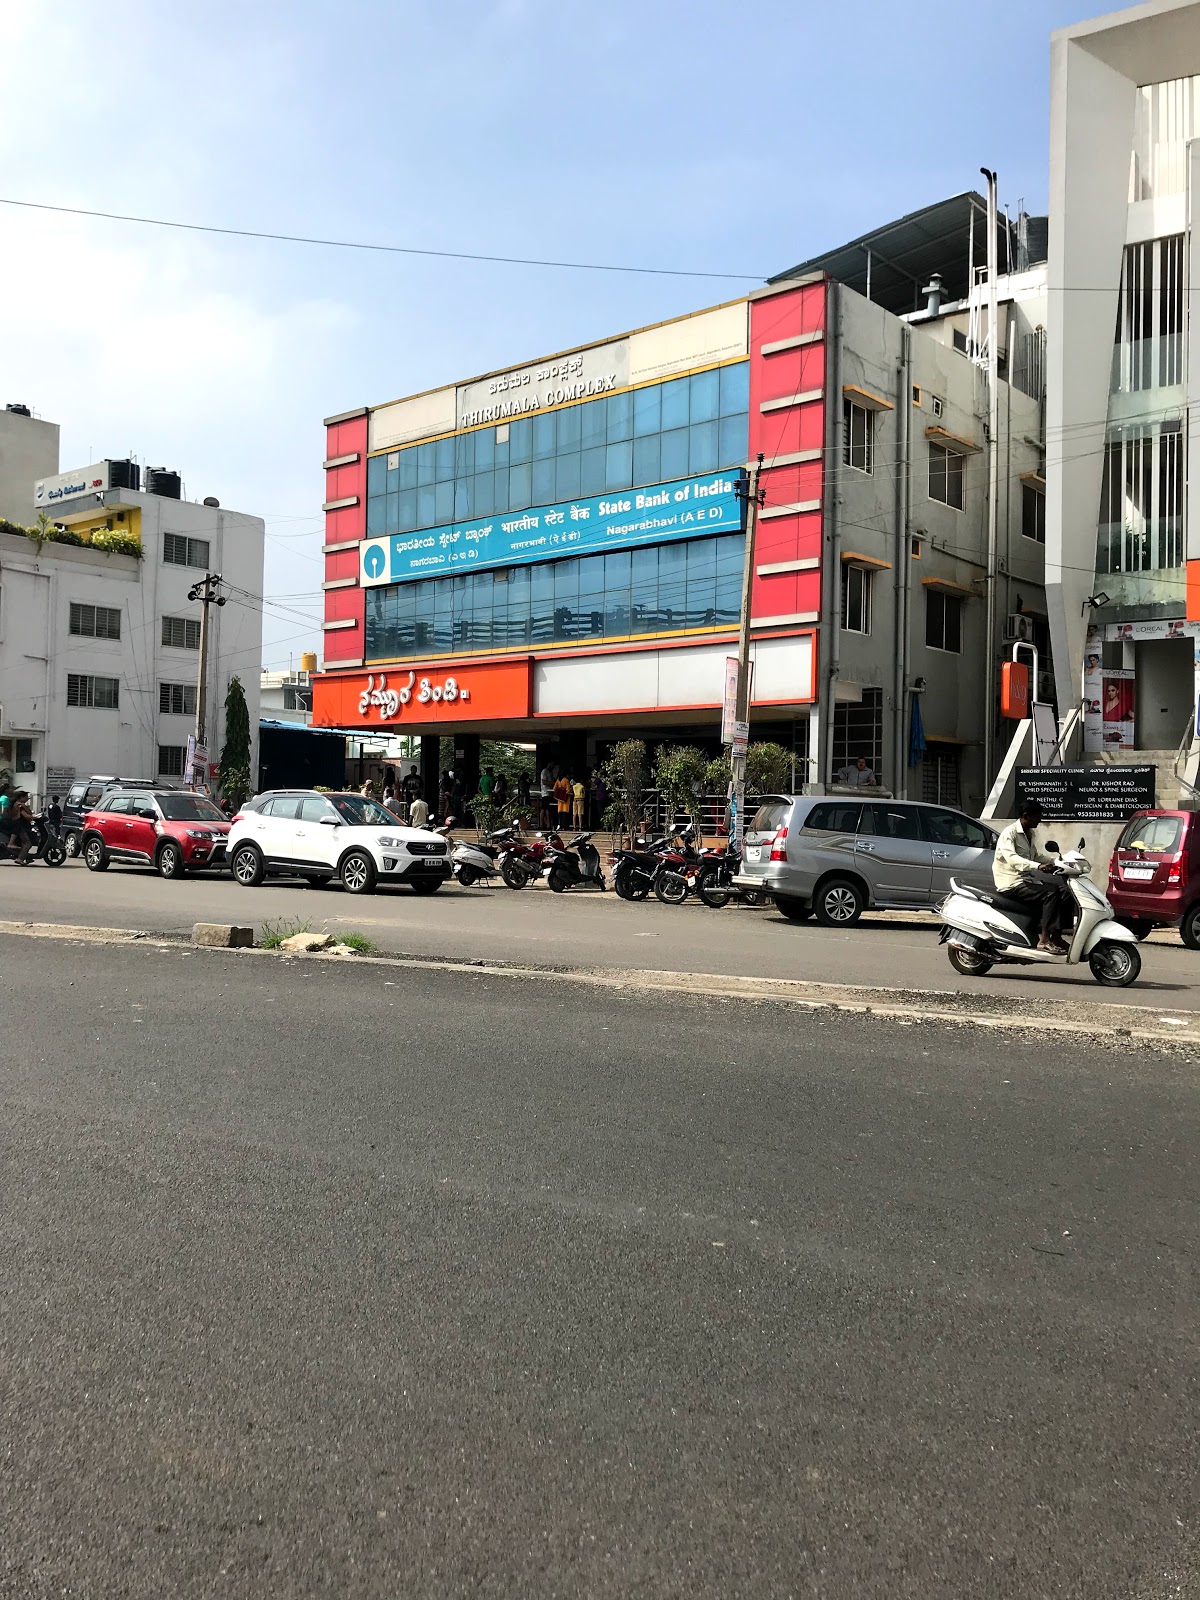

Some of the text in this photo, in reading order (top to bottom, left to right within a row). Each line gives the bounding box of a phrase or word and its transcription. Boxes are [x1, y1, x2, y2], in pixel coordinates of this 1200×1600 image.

[461, 374, 616, 428] THIRUMALA COMPLEX
[599, 479, 732, 516] State Bank of India
[501, 505, 590, 533] भारतीय स्टेट बैंक
[606, 506, 723, 536] Nagarabhavi (A E D)
[396, 536, 435, 553] ಭಾರತೀಯ
[465, 525, 493, 544] ಬ್ಯಾಂಕ್
[358, 671, 416, 720] ನಮ್ಮೂರ
